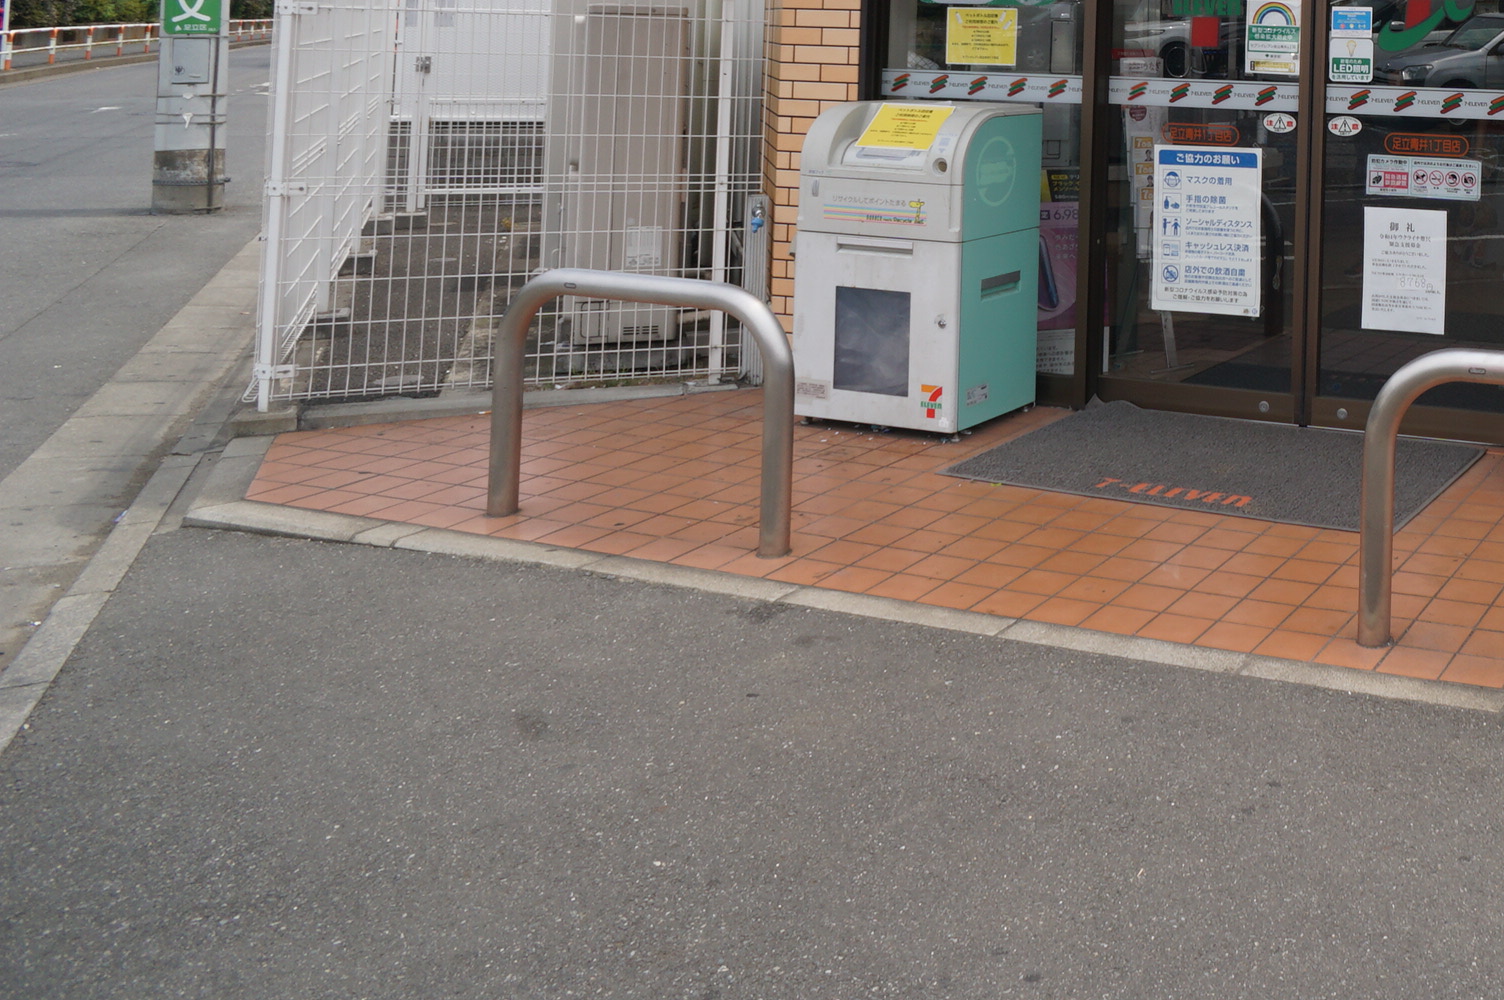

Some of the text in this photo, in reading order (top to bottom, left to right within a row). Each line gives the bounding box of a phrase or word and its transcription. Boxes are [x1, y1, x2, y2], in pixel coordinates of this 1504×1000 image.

[1333, 64, 1369, 73] LED照明
[1176, 153, 1240, 165] ご協力のお願い
[1186, 176, 1232, 186] マスクの着用
[1186, 195, 1226, 204] 手指の除菌
[1186, 218, 1253, 228] ソーシャルディスタンス
[1185, 241, 1249, 253] キャッシュレス決済
[1184, 265, 1246, 277] 店外での飲酒自粛
